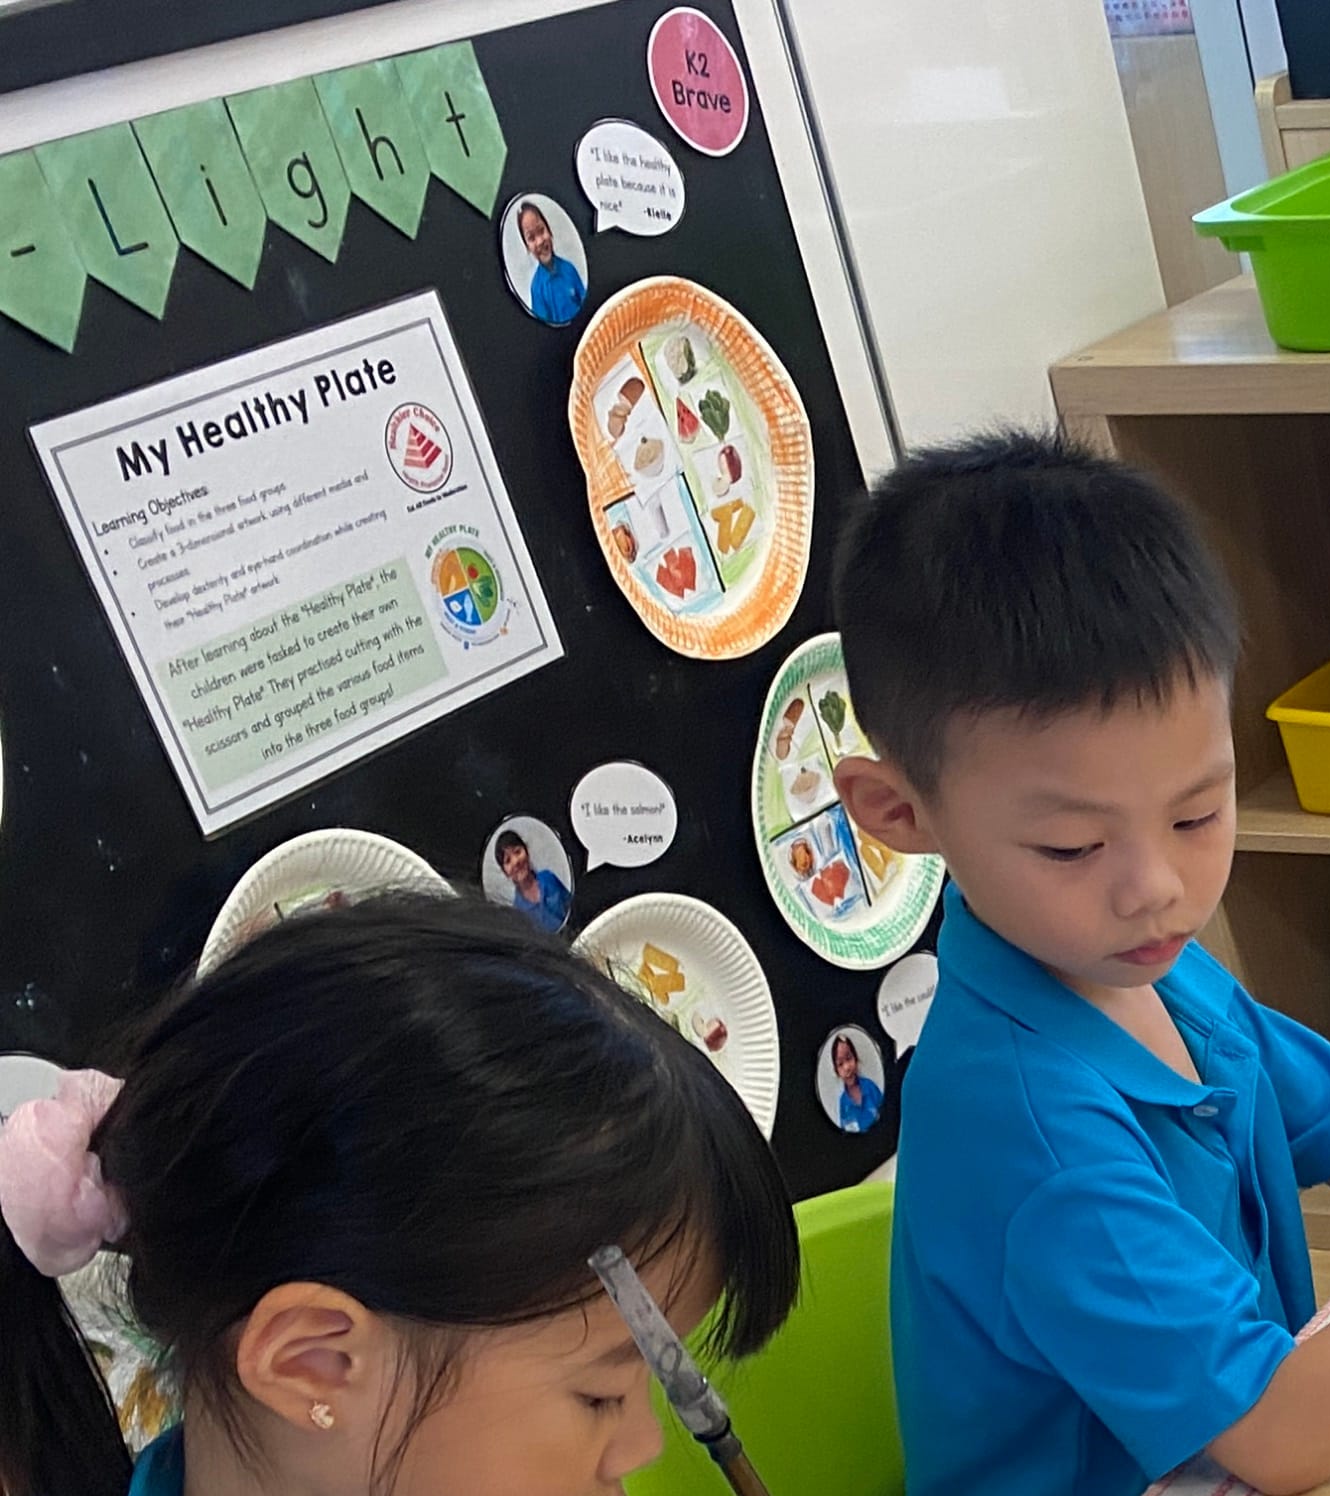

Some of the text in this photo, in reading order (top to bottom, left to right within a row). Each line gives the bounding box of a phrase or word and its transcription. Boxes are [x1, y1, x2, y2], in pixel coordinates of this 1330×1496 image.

[684, 48, 711, 78] K2
[671, 79, 732, 114] Brave
[595, 172, 619, 189] plate
[620, 175, 657, 194] because
[659, 183, 666, 197] it
[603, 149, 619, 165] like
[622, 153, 637, 168] the
[639, 155, 672, 177] healthy
[116, 358, 397, 482] My Healthy Plate
[91, 508, 149, 538] Learning
[128, 481, 287, 550] Classify food in the three food groups
[137, 551, 168, 571] Create
[169, 549, 177, 559] a
[236, 511, 267, 532] artwork
[268, 503, 292, 521] using
[292, 486, 328, 509] different
[353, 469, 369, 485] and
[431, 524, 458, 546] HEALTHY
[458, 523, 480, 539] PLATE
[147, 566, 191, 593] processes
[154, 589, 191, 613] Develop
[191, 573, 230, 597] dexterity
[230, 563, 247, 580] and
[285, 531, 333, 558] coordination
[333, 520, 354, 537] while
[354, 508, 388, 529] creating
[249, 573, 281, 597] artwork
[167, 656, 201, 679] After
[200, 636, 249, 664] learning
[249, 619, 280, 643] about
[280, 610, 301, 629] the
[379, 567, 398, 585] the
[190, 597, 399, 700] children were tasked to create their own
[267, 674, 296, 697] They
[297, 649, 345, 686] practised
[344, 632, 382, 661] cutting
[382, 622, 405, 643] with
[405, 613, 424, 632] the
[203, 642, 425, 758] scissors and grouped the various food items
[260, 743, 284, 761] into
[284, 732, 304, 749] the
[304, 716, 334, 738] three
[333, 703, 358, 723] food
[593, 802, 610, 816] like
[612, 802, 628, 816] the
